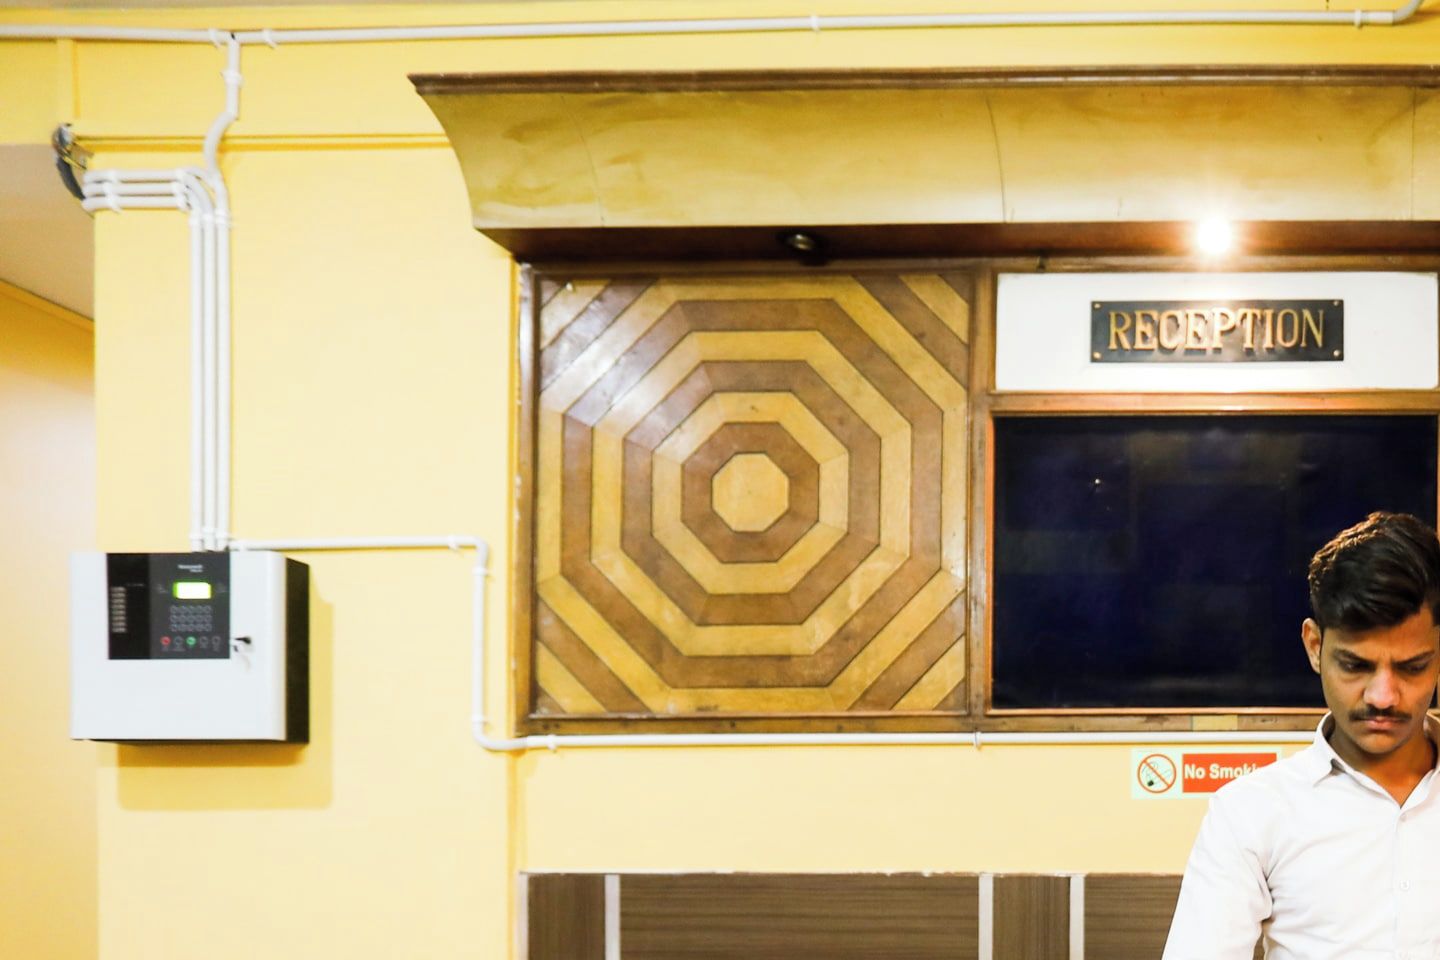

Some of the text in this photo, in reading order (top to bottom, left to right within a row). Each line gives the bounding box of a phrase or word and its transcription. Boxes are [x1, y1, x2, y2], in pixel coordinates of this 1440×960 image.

[1108, 307, 1325, 351] RECEPTION
[1184, 762, 1258, 780] No Smok
